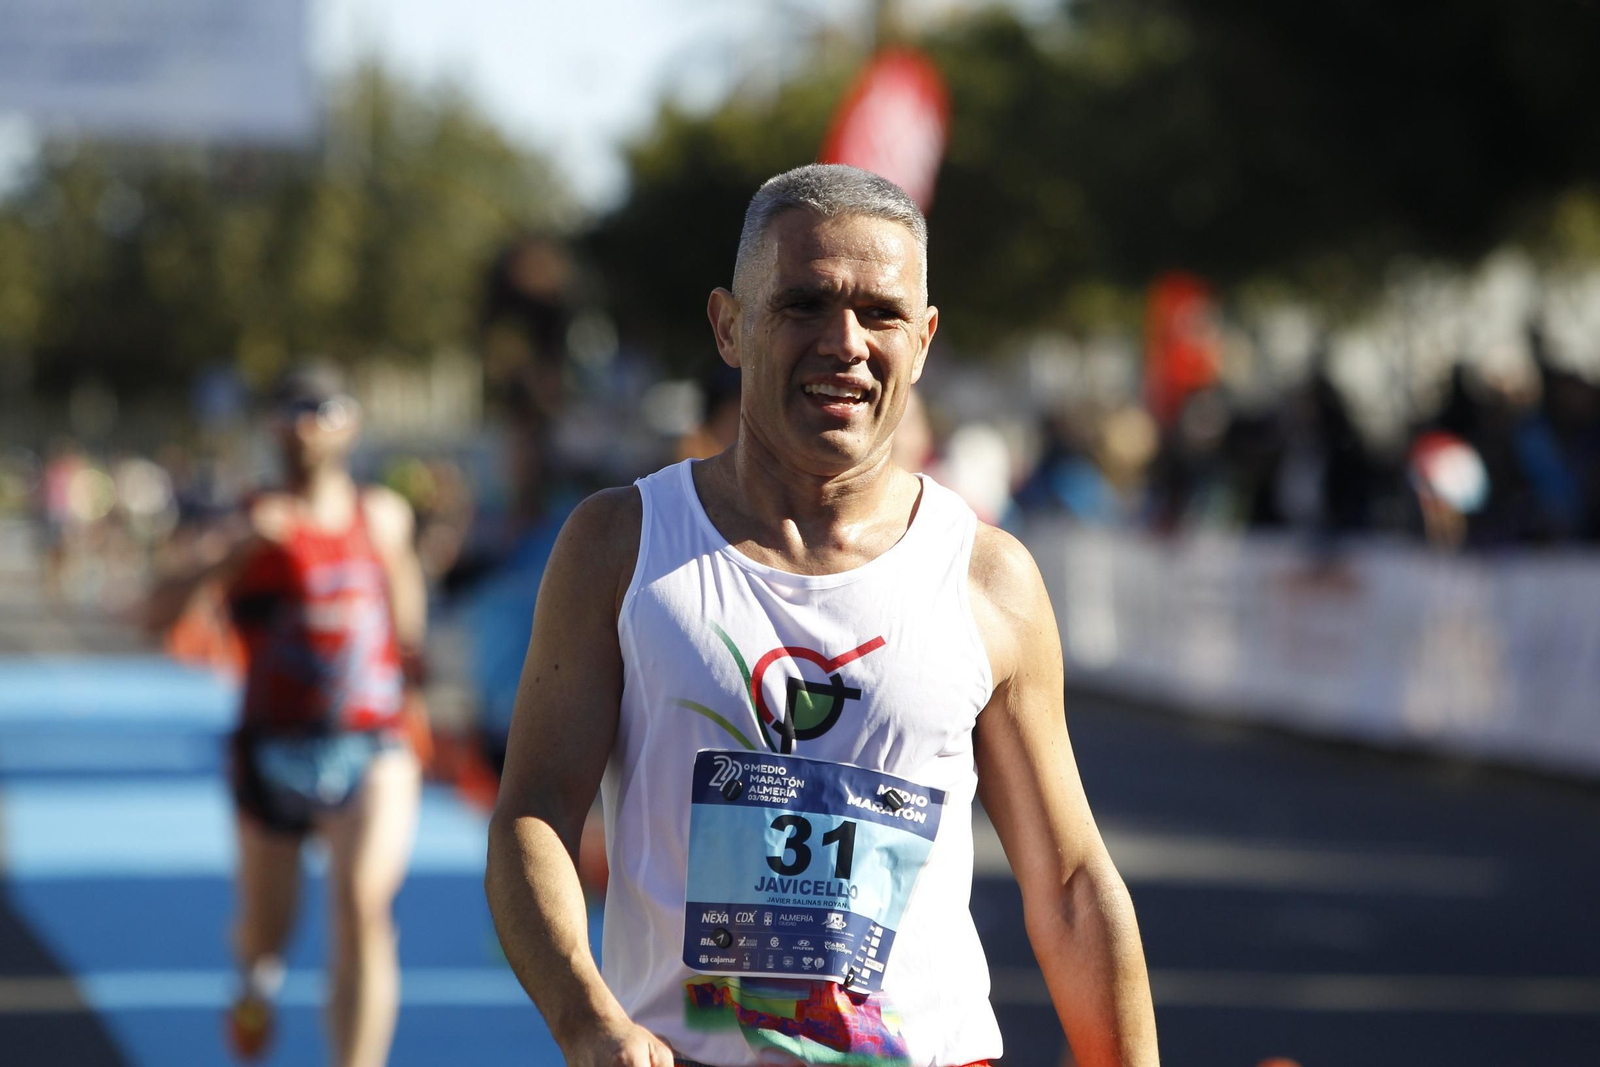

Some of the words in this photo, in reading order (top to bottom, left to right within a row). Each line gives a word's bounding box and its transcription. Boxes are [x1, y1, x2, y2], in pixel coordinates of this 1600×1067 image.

[750, 763, 787, 776] MEDIO
[749, 774, 805, 789] MARATÓN
[748, 785, 798, 799] ALMERÍA
[747, 794, 789, 805] 03/02/2019
[765, 814, 857, 880] 31
[754, 876, 858, 900] JAVICELLO
[766, 896, 791, 905] JAVIER
[791, 898, 822, 907] SALINAS
[701, 912, 729, 924] NEXA
[735, 911, 757, 923] CDX
[779, 913, 814, 923] ALMERÍA
[709, 955, 737, 965] cajamar
